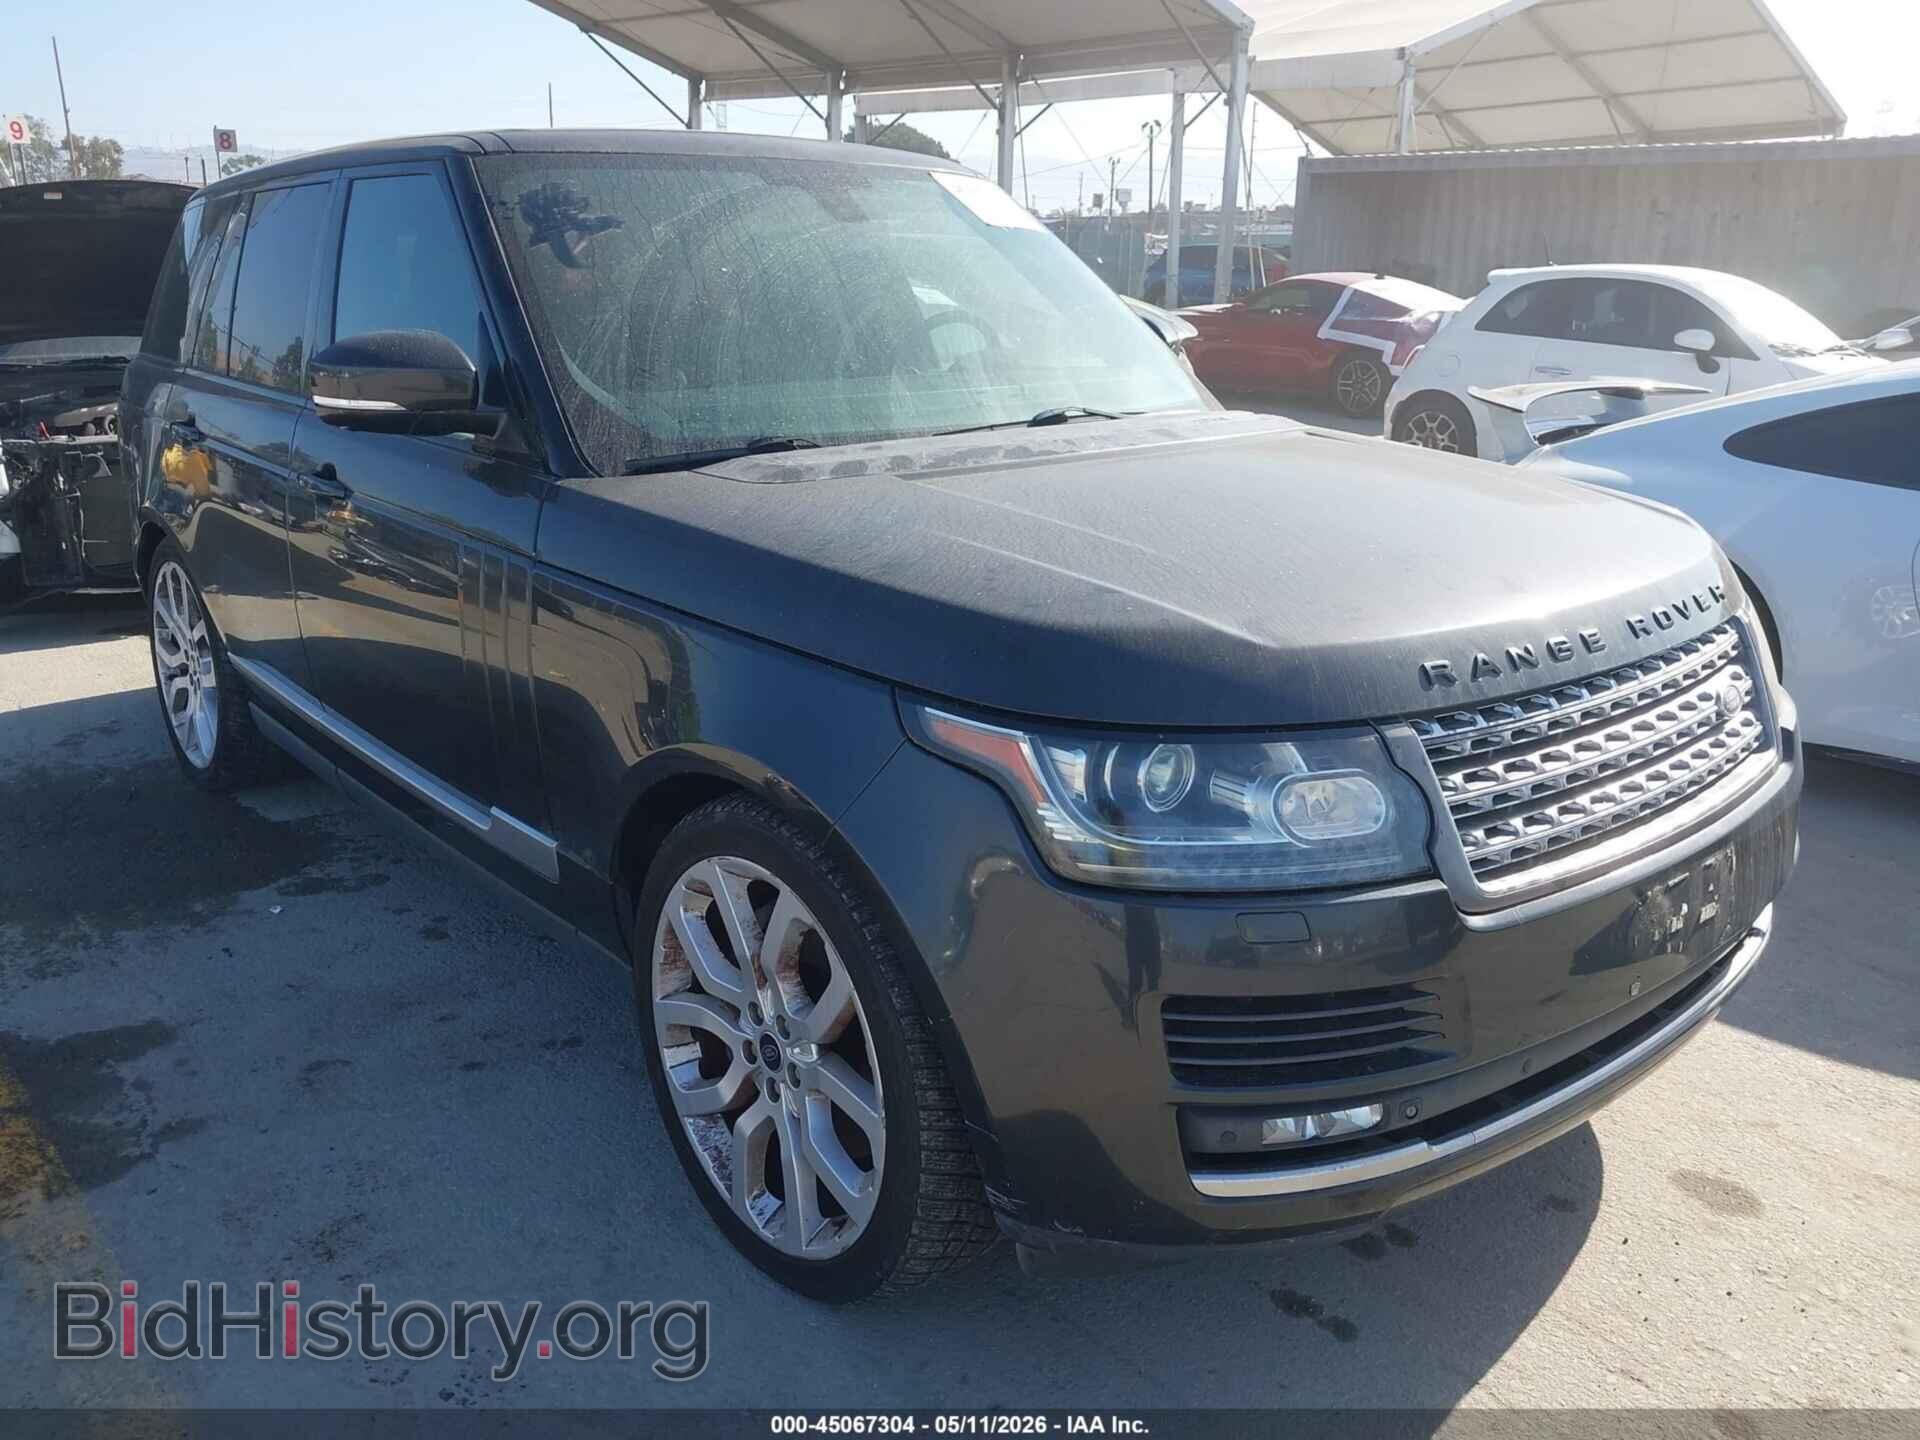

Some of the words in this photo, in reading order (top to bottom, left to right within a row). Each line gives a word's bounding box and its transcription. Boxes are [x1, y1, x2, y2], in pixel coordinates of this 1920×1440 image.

[9, 121, 24, 140] 9
[218, 132, 233, 149] 8
[1419, 628, 1607, 691] RANGE
